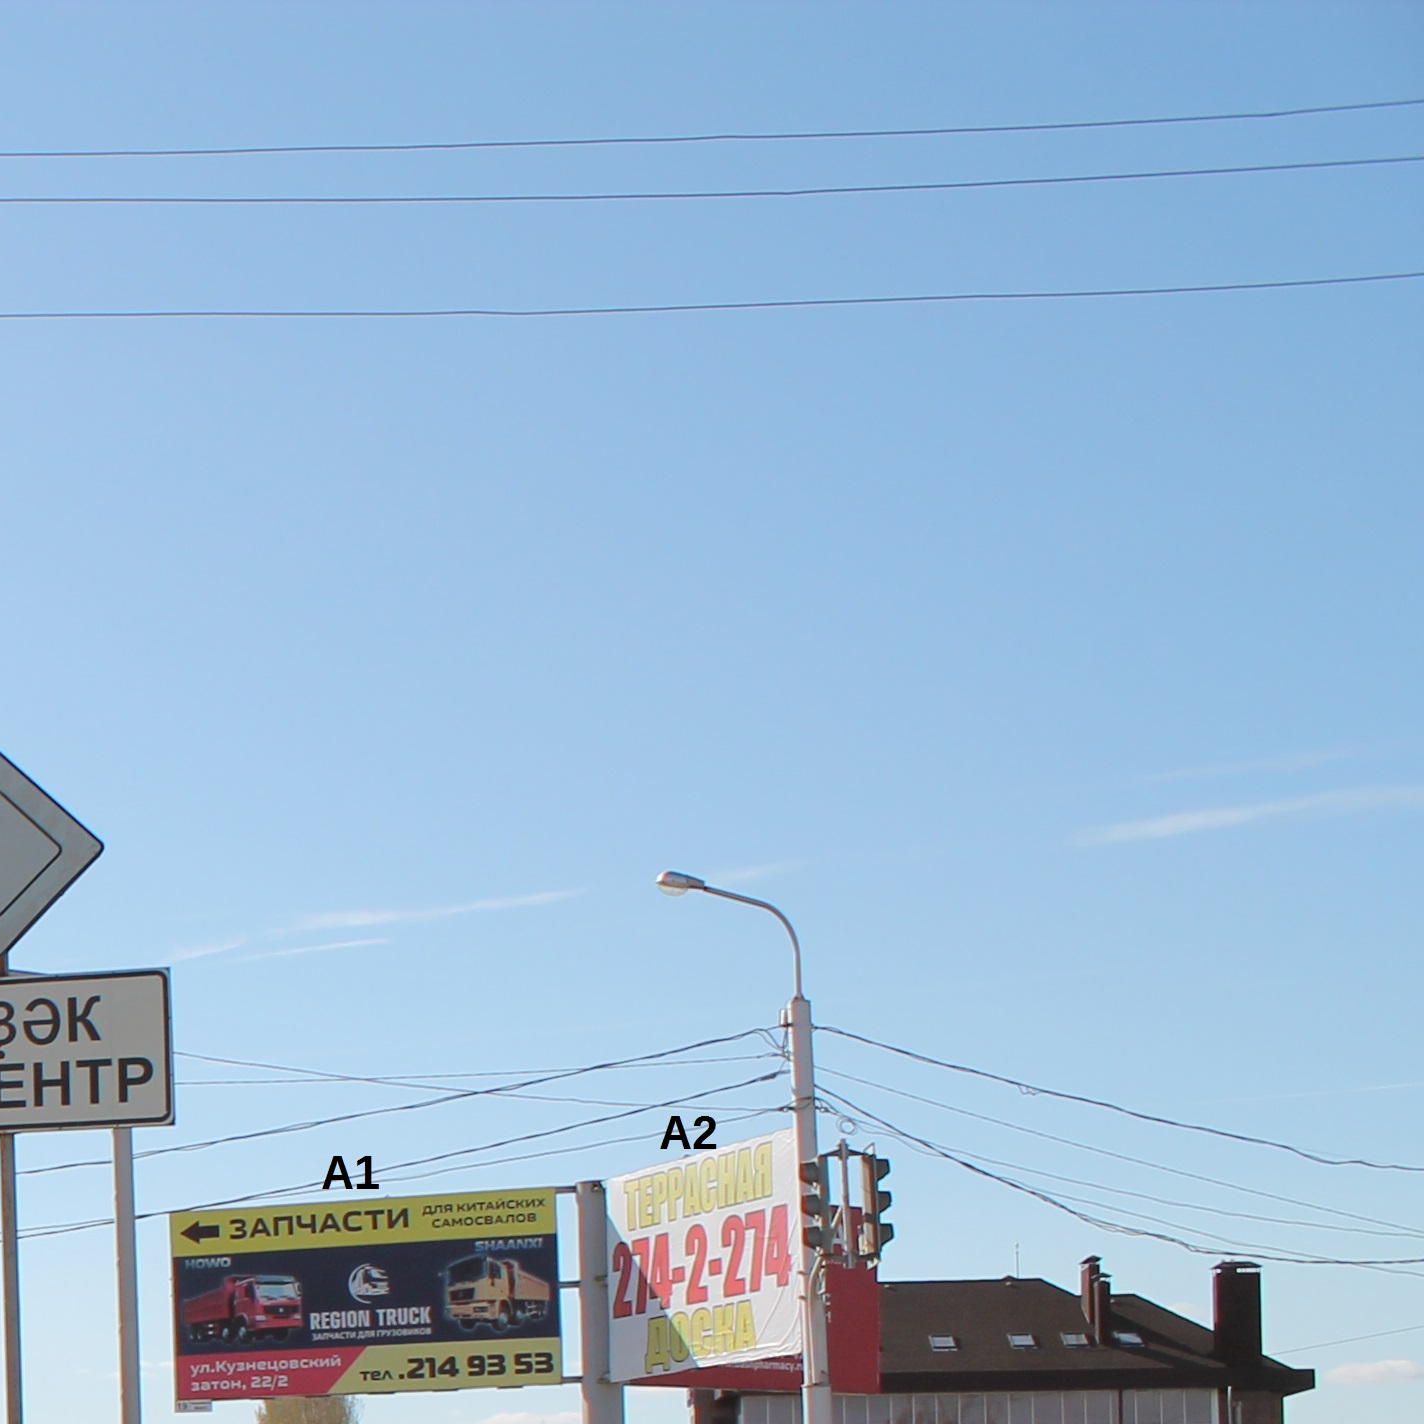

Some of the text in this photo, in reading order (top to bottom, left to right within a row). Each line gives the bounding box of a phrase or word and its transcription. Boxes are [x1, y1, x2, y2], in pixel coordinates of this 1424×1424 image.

[623, 1140, 773, 1232] ТЕРРАСНАЯ
[422, 1198, 545, 1217] ДЛЯ КИТАЙСКИХ
[229, 1208, 409, 1240] ЗАПЧАСТИ
[432, 1213, 536, 1229] САМОСВАЛОВ
[475, 1237, 543, 1252] SHAANXI
[185, 1257, 231, 1270] HOWO
[612, 1203, 791, 1319] 274-2-274
[309, 1306, 432, 1330] REGION TRUCK
[312, 1327, 432, 1341] ЗАПЧАСТИ ДЛЯ ГРУЗОВИКОВ
[644, 1299, 756, 1375] ДОСКА
[190, 1355, 342, 1377] ул.Кузнецовский
[467, 1354, 506, 1377] 93
[514, 1352, 554, 1375] 53
[191, 1375, 289, 1391] затон, 22/2
